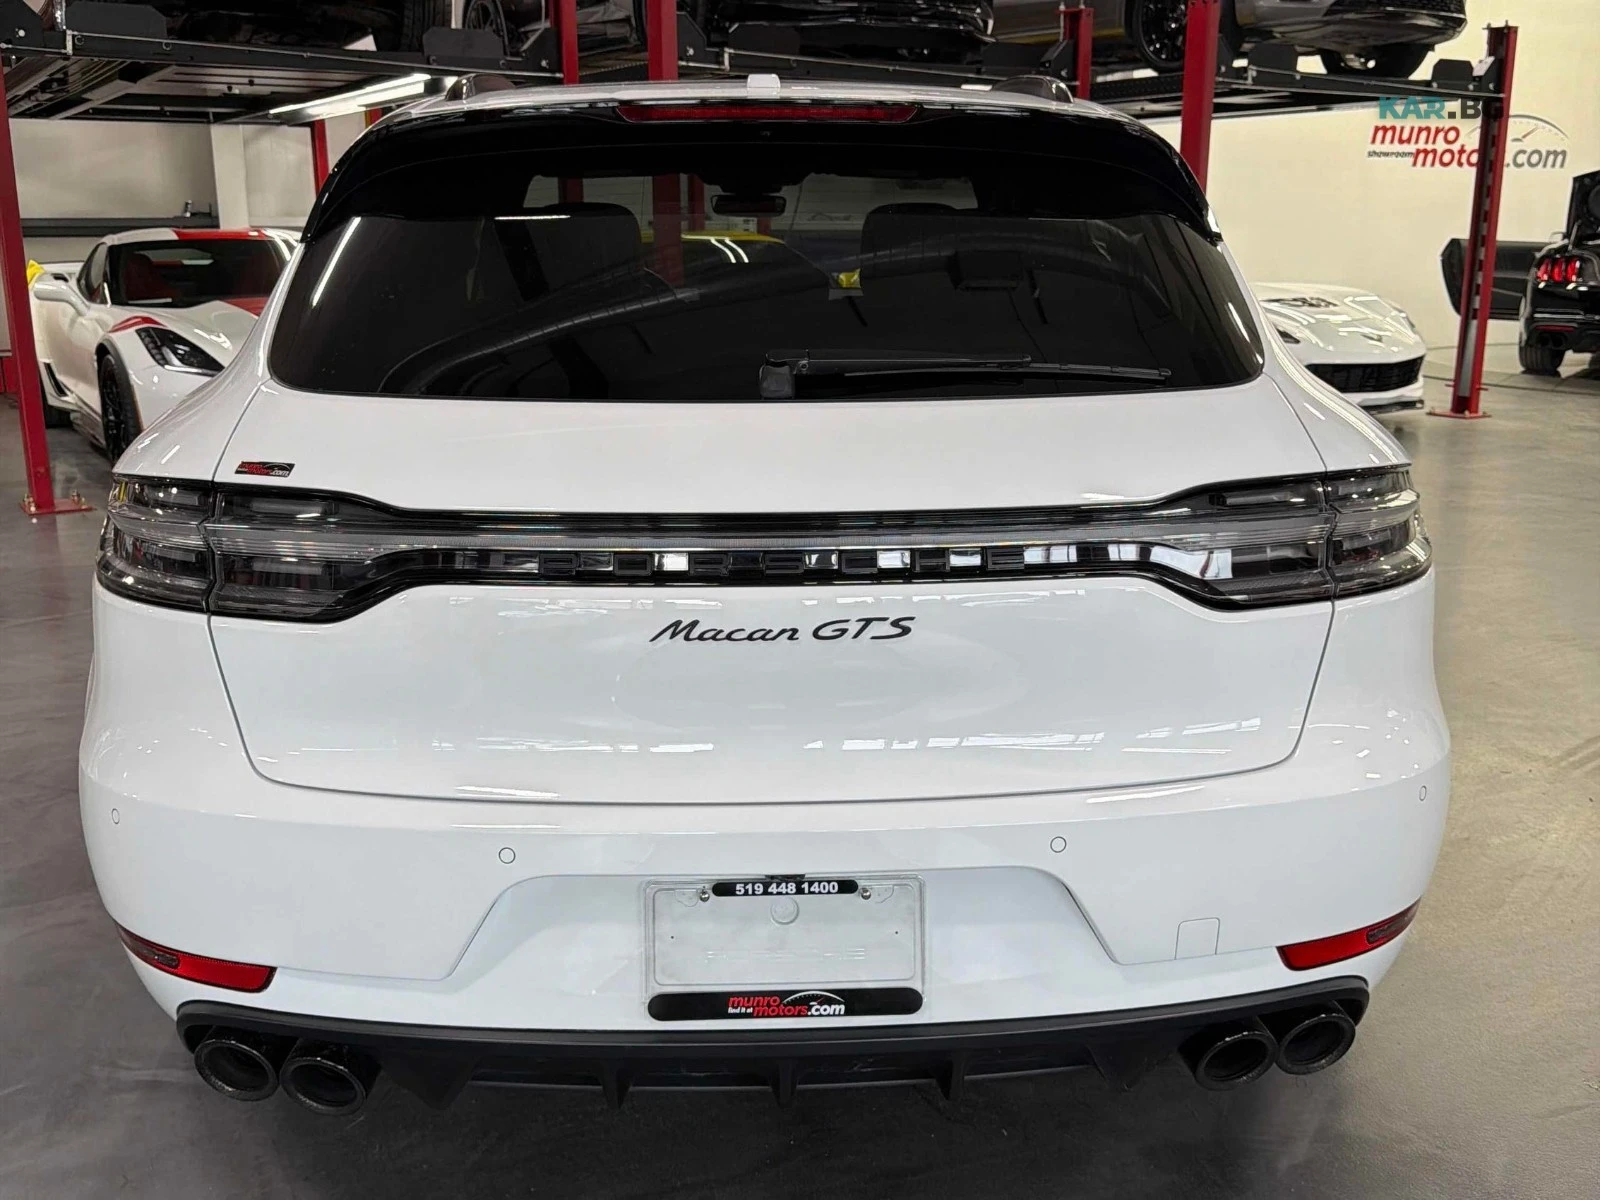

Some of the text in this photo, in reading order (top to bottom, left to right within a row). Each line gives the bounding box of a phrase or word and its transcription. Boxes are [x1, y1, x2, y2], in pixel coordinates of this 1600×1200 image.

[1370, 124, 1460, 145] munro
[1411, 144, 1567, 169] moto.com
[539, 547, 1025, 577] PORSCHE
[649, 616, 916, 642] Macan GTS
[735, 882, 839, 895] 519 448 1400
[728, 996, 780, 1007] munro
[752, 1003, 845, 1017] motors.com
